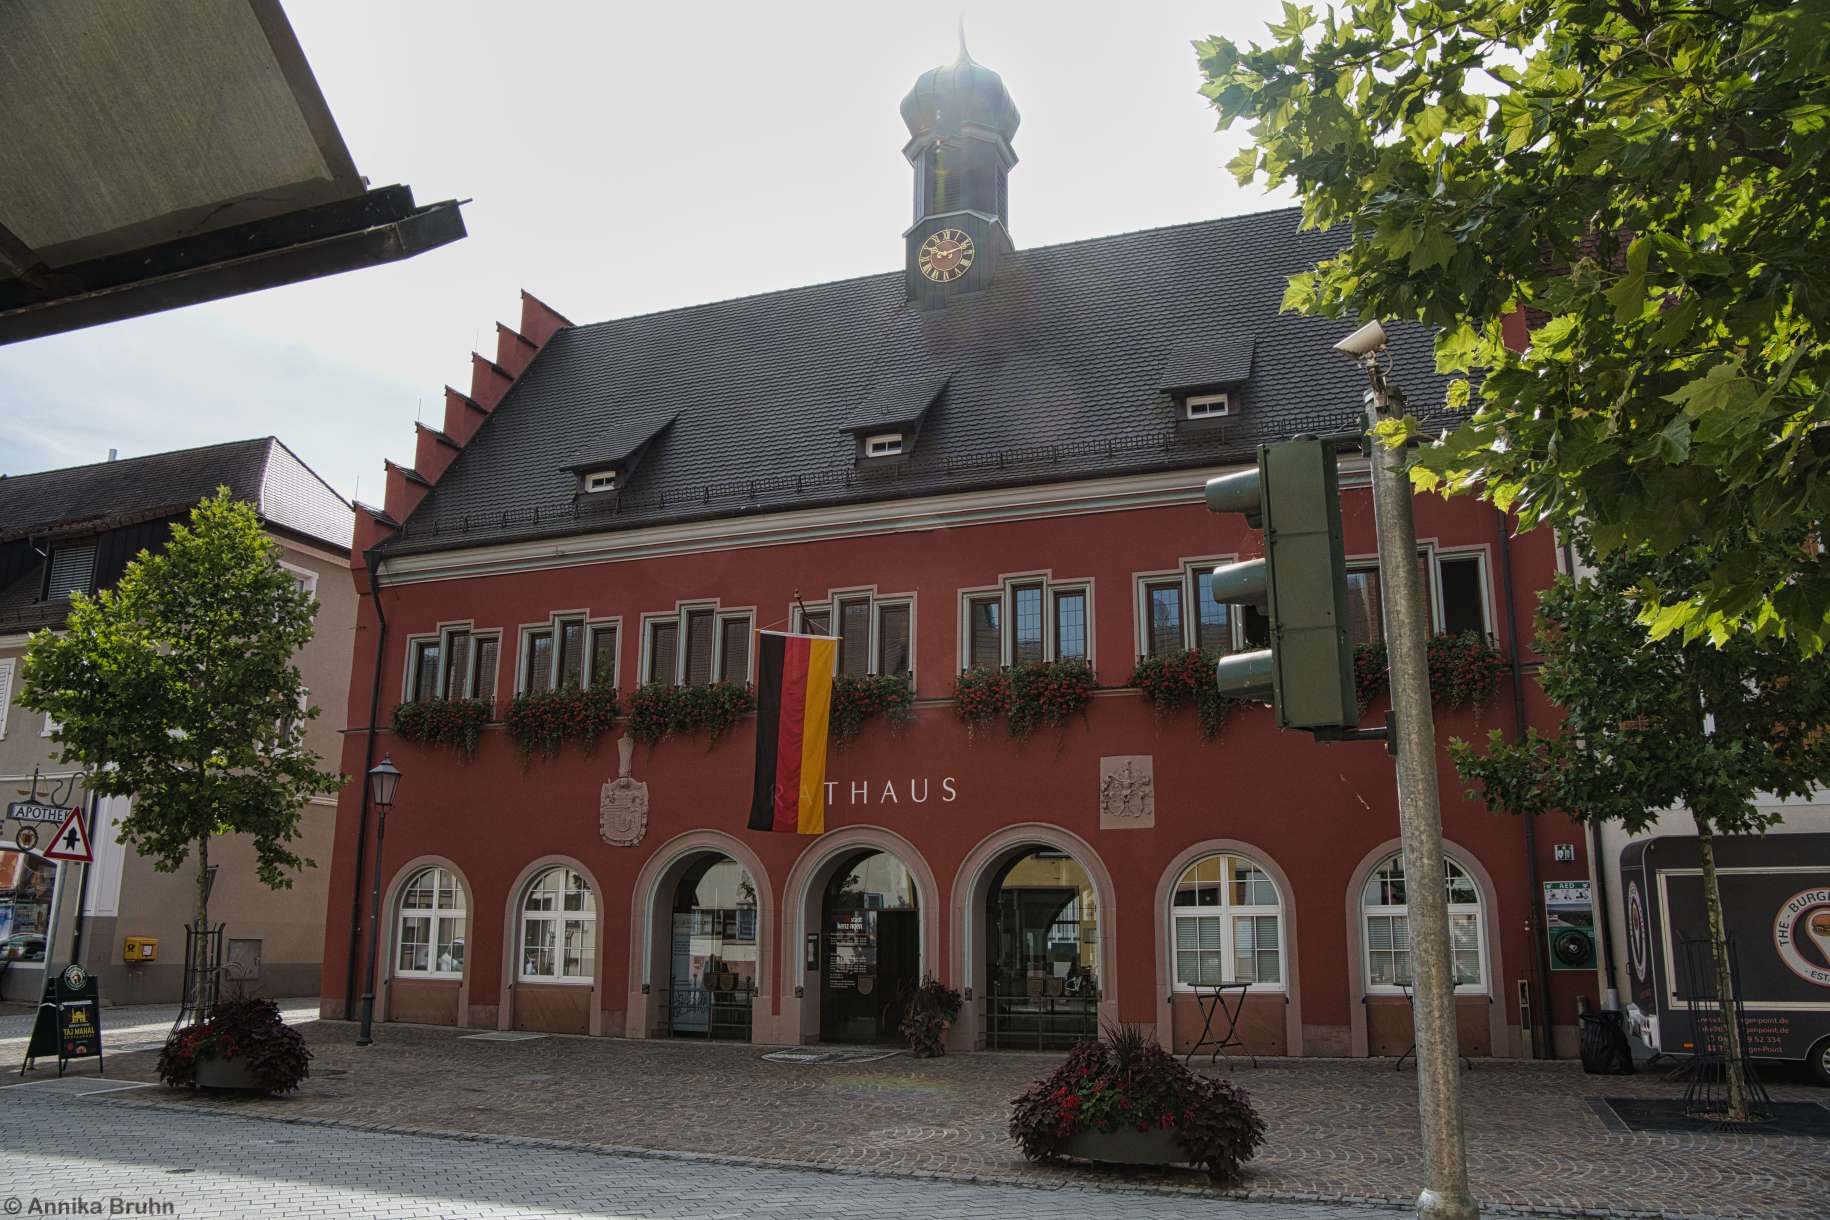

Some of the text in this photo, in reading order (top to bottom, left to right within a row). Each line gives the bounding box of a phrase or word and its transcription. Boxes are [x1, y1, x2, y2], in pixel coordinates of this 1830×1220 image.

[15, 806, 72, 821] APOTHEK
[1778, 891, 1830, 947] THE BURG
[63, 1026, 95, 1036] TAJ MAHAL
